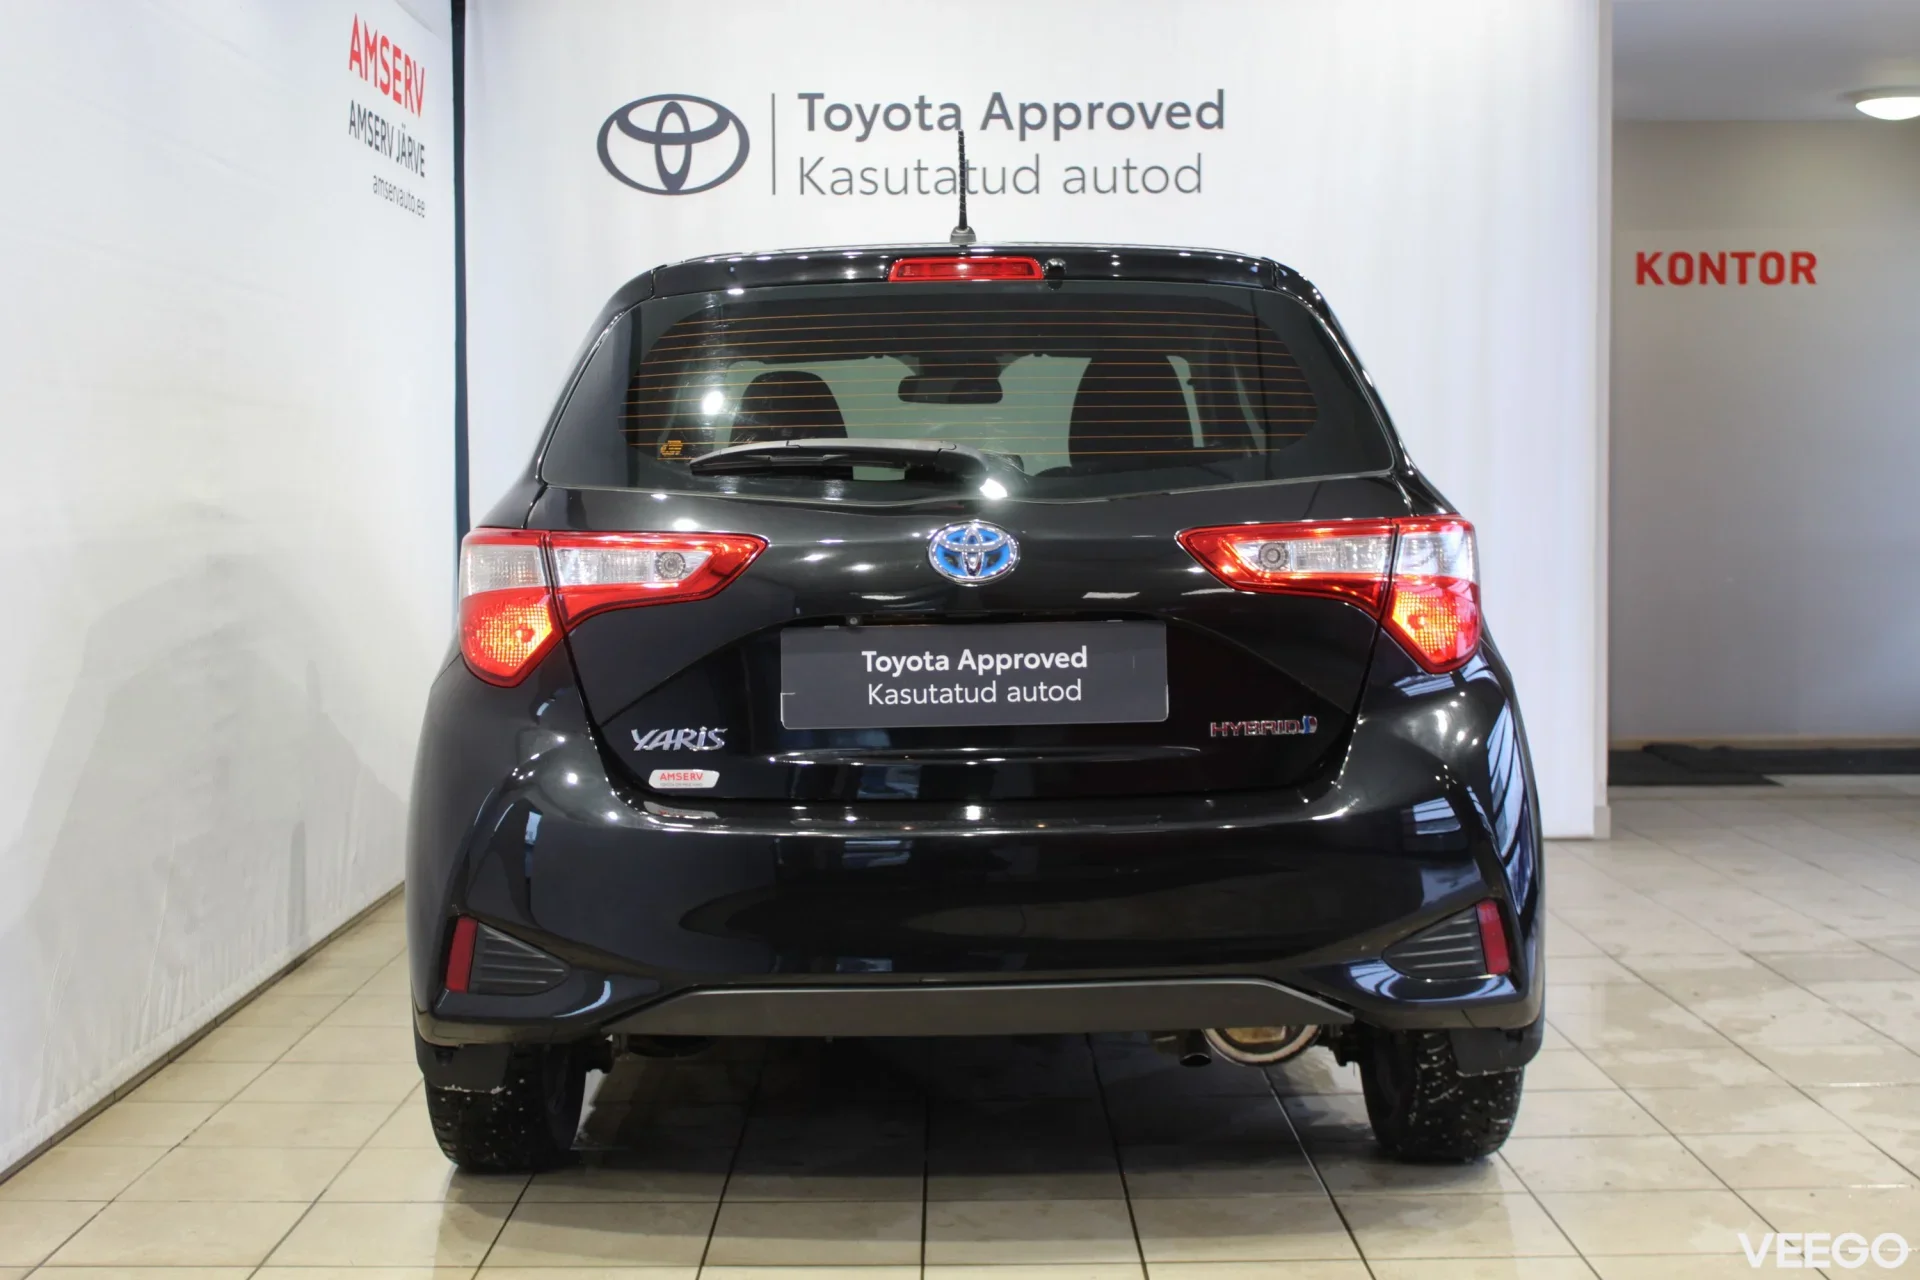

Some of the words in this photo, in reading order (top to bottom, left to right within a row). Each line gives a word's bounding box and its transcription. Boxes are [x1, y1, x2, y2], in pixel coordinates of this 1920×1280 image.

[349, 12, 425, 118] AMSERV
[798, 92, 962, 142] Toyota
[980, 89, 1225, 141] Approved
[349, 99, 395, 160] AMSERV
[395, 122, 426, 178] JÄRVE
[799, 152, 1040, 195] Kasutatud
[1063, 153, 1202, 195] autod
[372, 174, 426, 219] amservauto.ee
[1635, 251, 1817, 286] KONTOR
[861, 649, 950, 678] Toyota
[957, 645, 1088, 676] Approved
[868, 680, 997, 706] Kasutatud
[1006, 678, 1082, 703] autod
[1210, 719, 1301, 737] HYBRID
[660, 772, 704, 781] AMSERV
